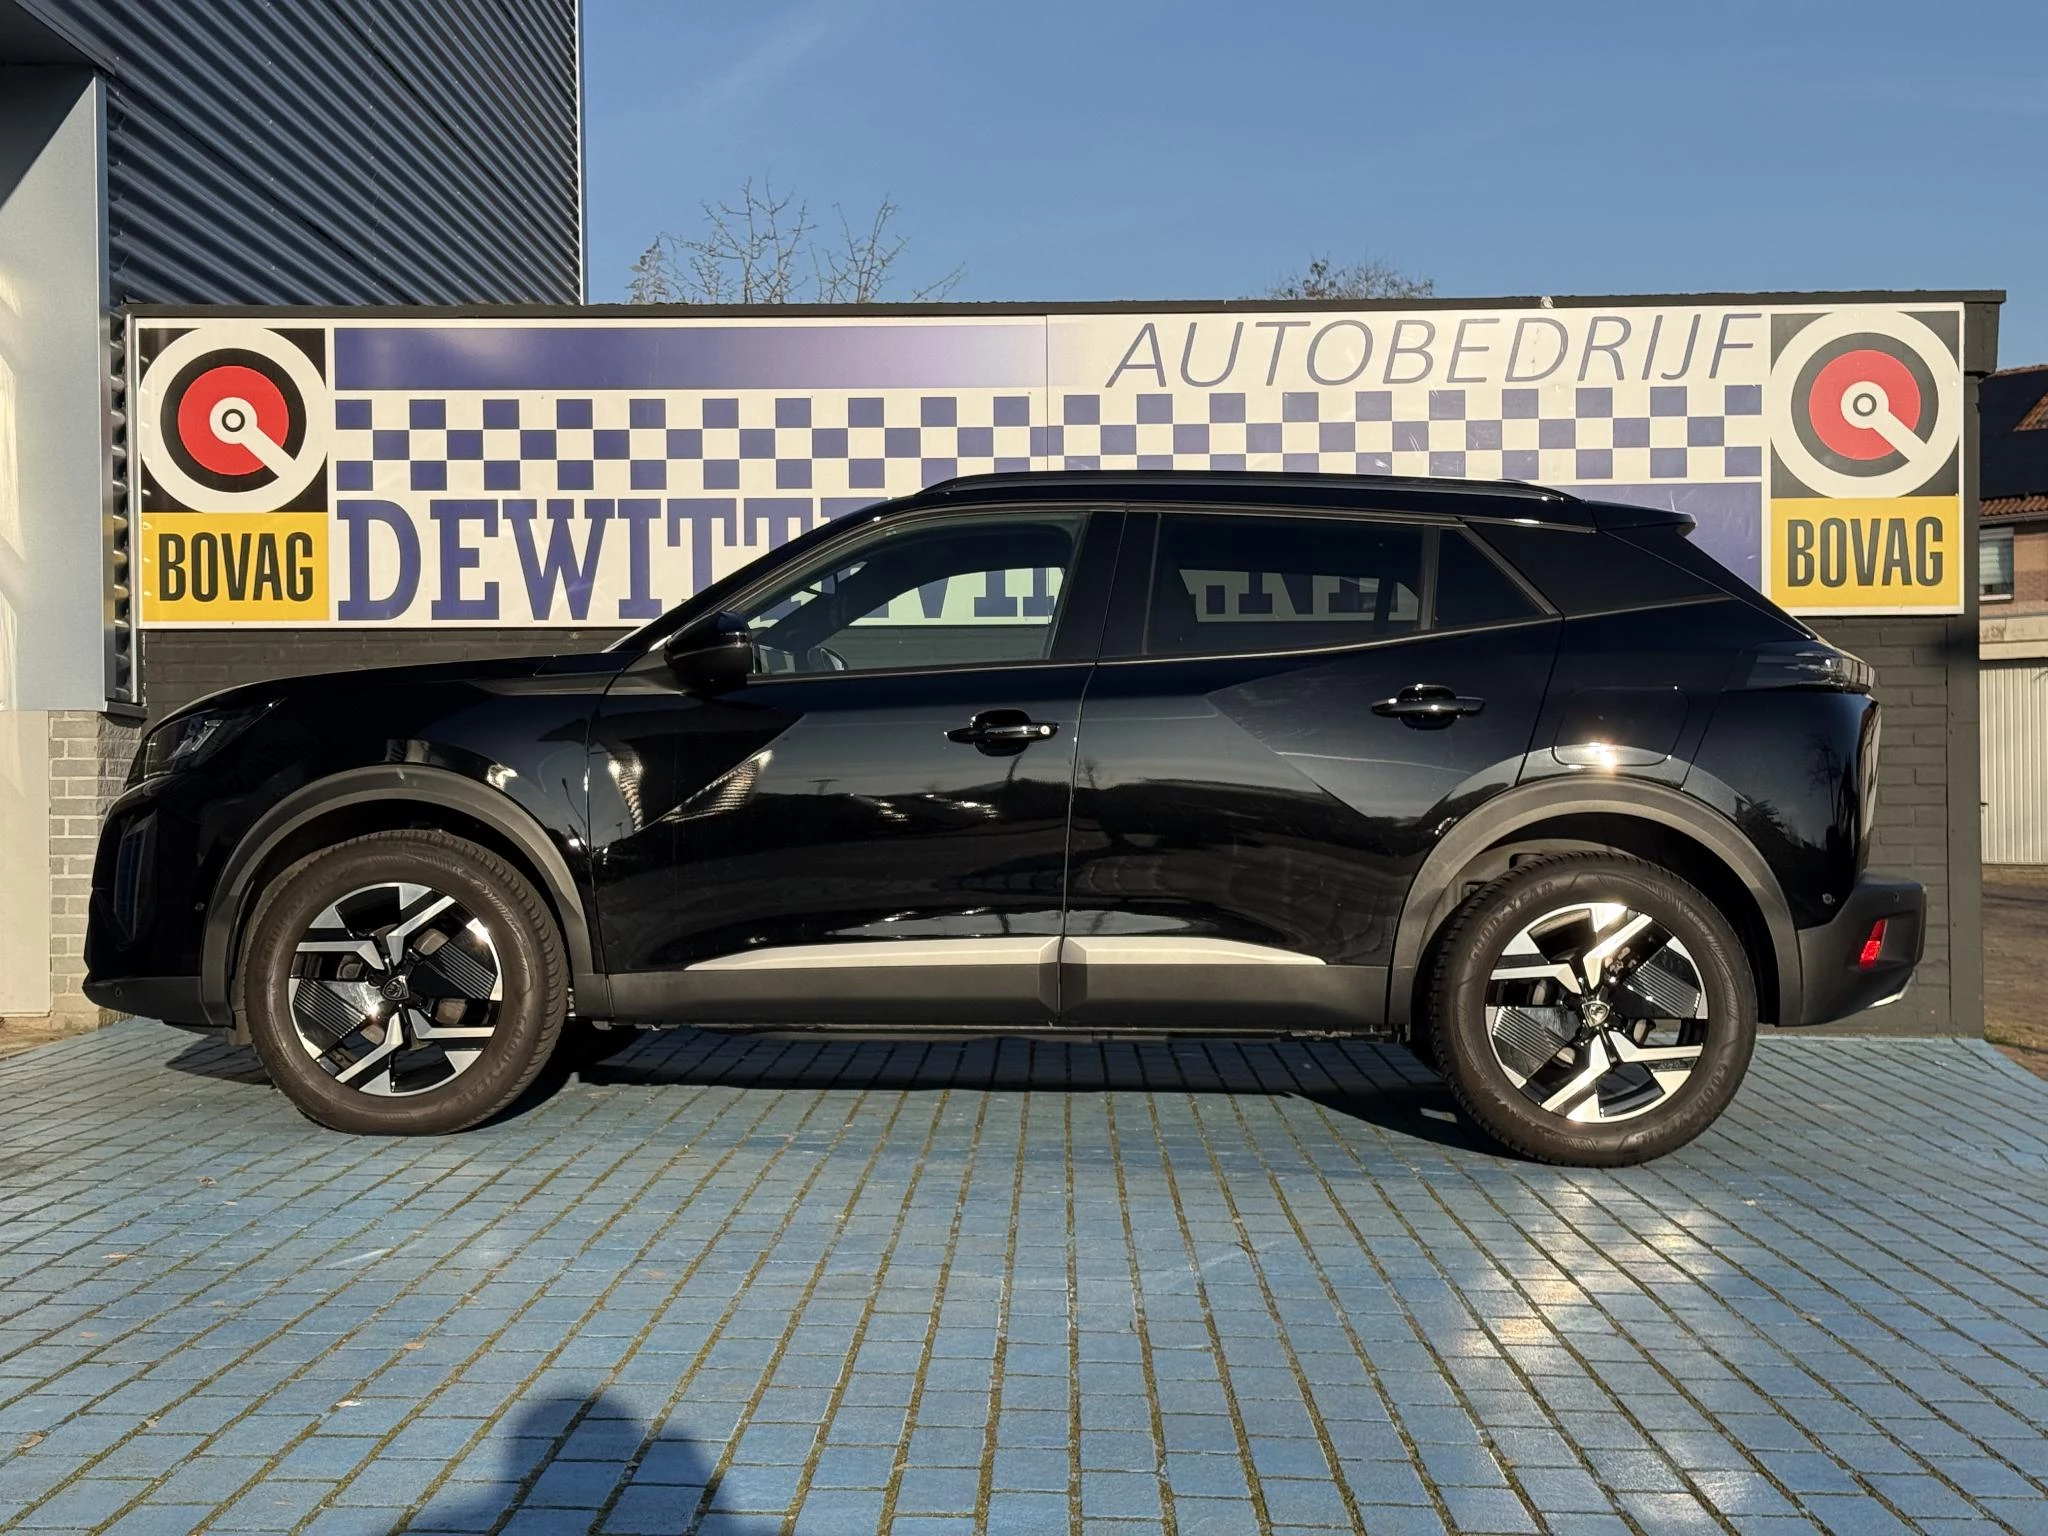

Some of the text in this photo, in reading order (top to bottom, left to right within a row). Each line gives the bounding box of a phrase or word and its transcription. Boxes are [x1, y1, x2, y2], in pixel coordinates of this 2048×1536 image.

[1105, 312, 1763, 388] AUTOBEDRIJF
[158, 531, 314, 603] BOVAG
[1787, 516, 1943, 588] BOVAG
